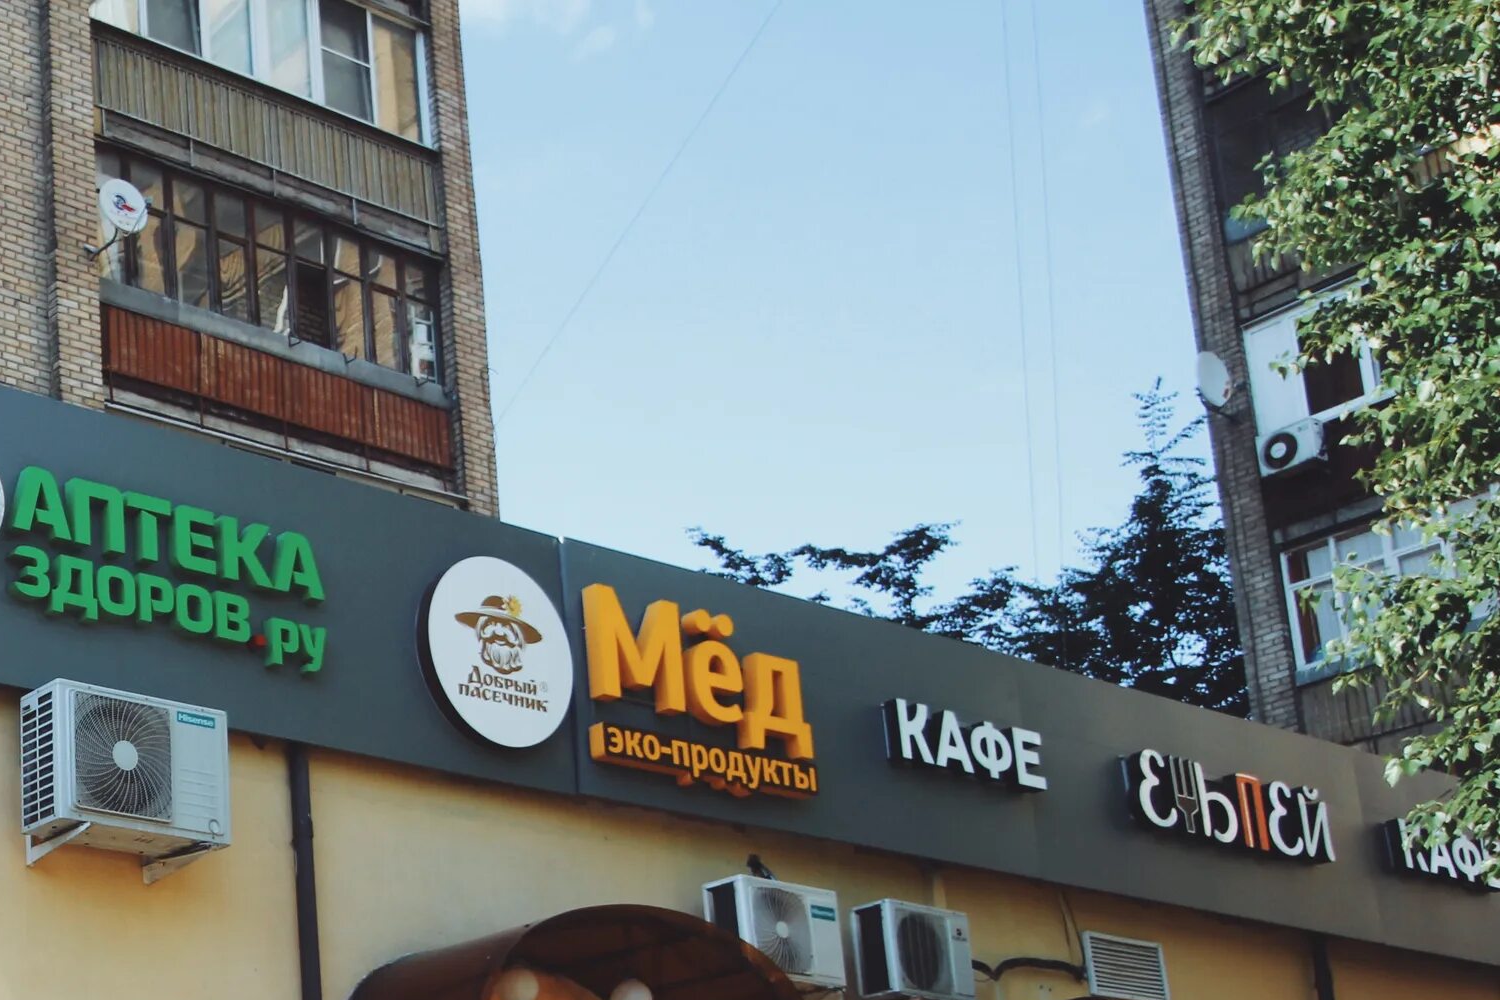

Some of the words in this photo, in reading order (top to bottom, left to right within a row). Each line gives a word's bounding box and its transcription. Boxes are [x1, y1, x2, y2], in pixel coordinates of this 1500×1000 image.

[11, 465, 326, 602] АПТЕКА
[582, 583, 814, 759] Мёд
[178, 712, 214, 727] Hisense
[895, 697, 1048, 790] КАФЕ
[1397, 817, 1500, 890] КАФ
